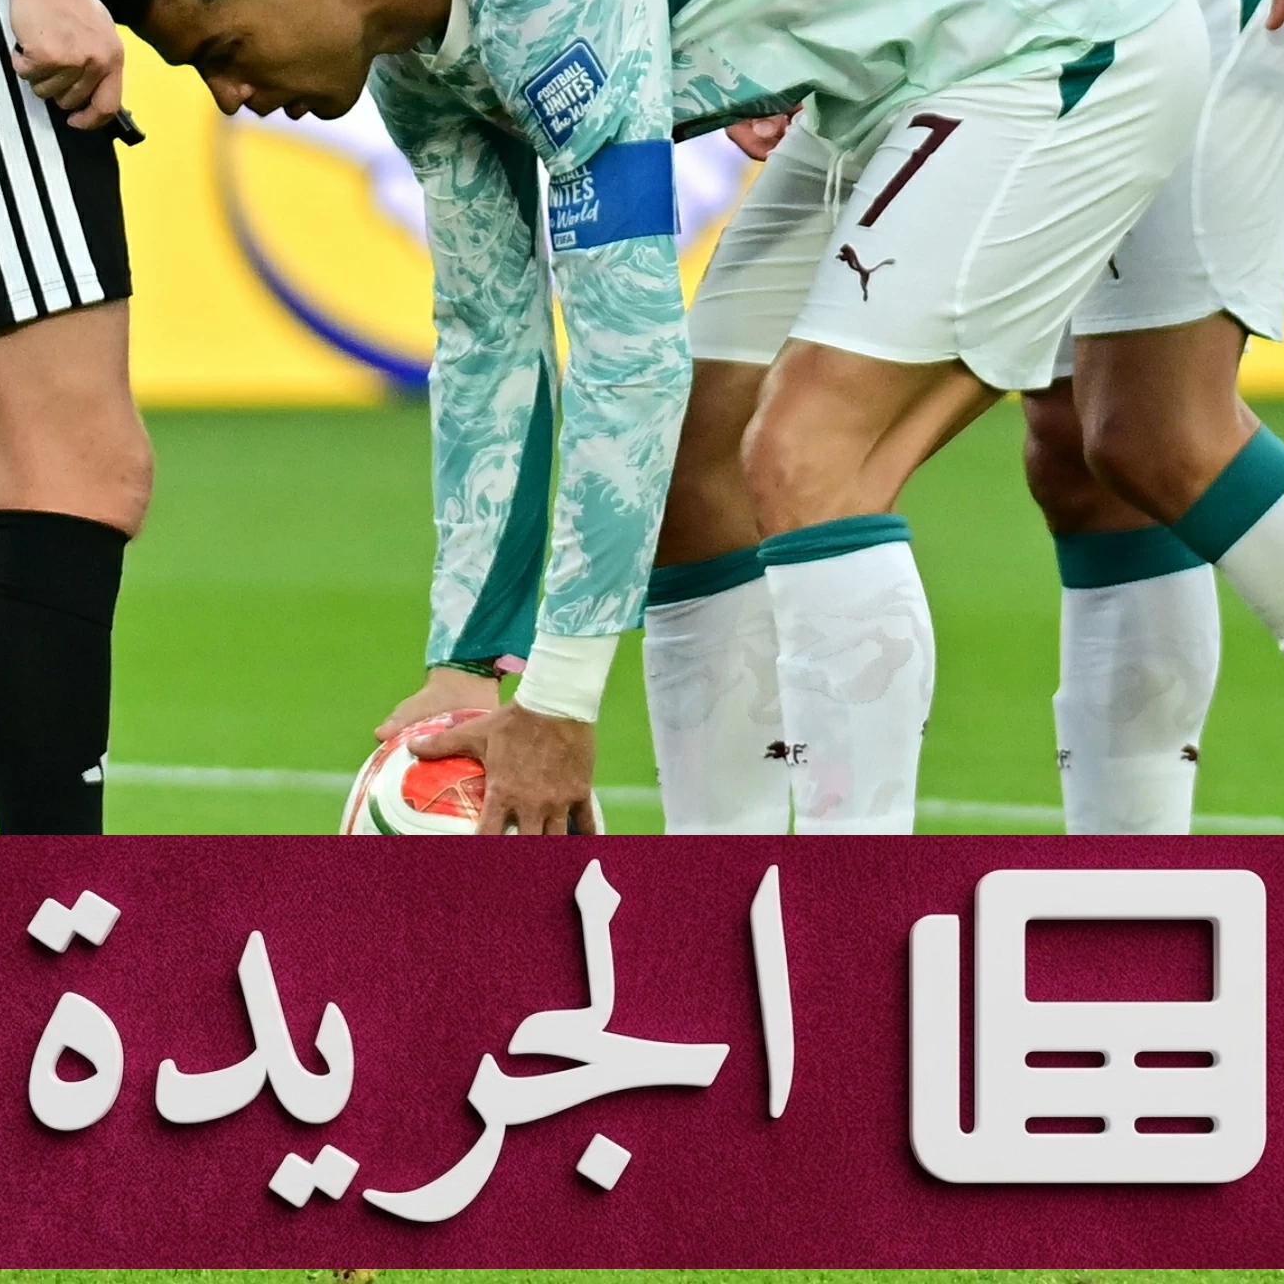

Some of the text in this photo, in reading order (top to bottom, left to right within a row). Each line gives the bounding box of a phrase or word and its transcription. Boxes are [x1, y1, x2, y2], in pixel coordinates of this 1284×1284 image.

[537, 60, 586, 103] FOOTBALL
[543, 71, 594, 116] UNITES
[857, 112, 964, 228] 7
[549, 177, 595, 208] NITES
[556, 199, 600, 229] World
